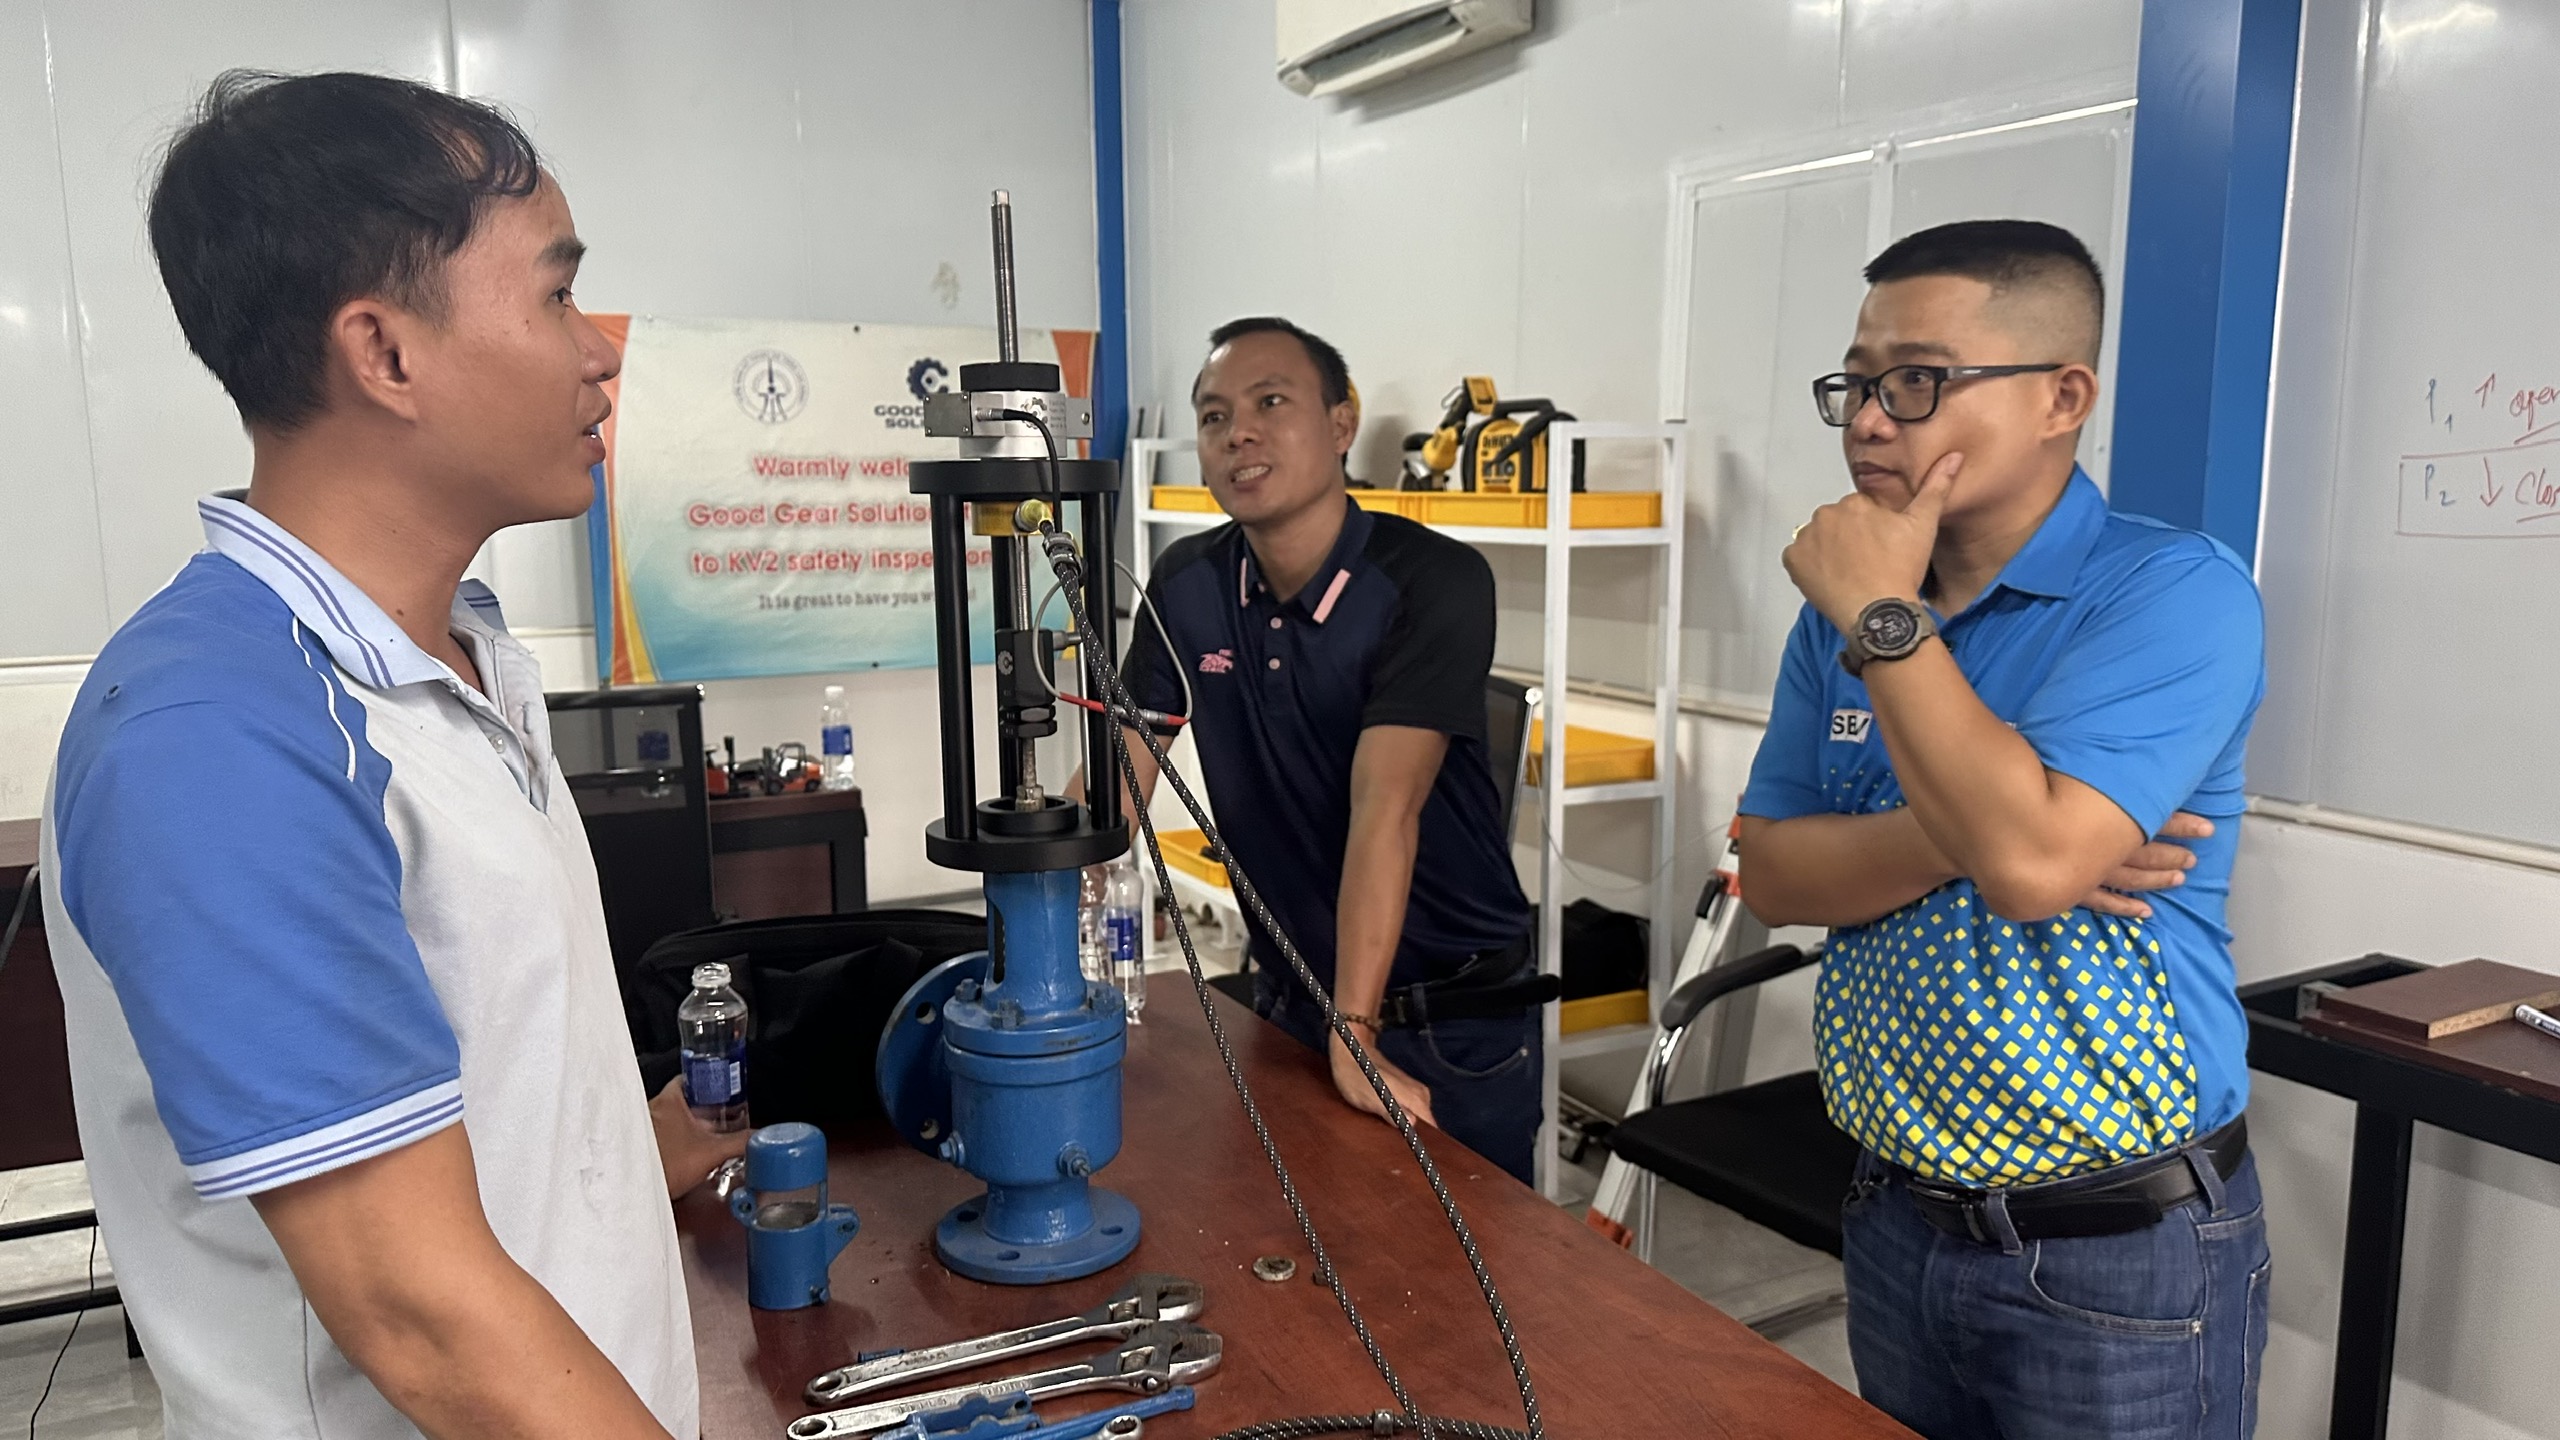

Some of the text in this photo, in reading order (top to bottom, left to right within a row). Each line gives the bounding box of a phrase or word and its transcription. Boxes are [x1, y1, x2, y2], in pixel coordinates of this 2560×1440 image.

[885, 418, 924, 429] SOL
[754, 456, 850, 480] Warmly
[688, 502, 931, 526] Good Gear Solutio
[693, 549, 992, 574] to KV2 safety inspeon
